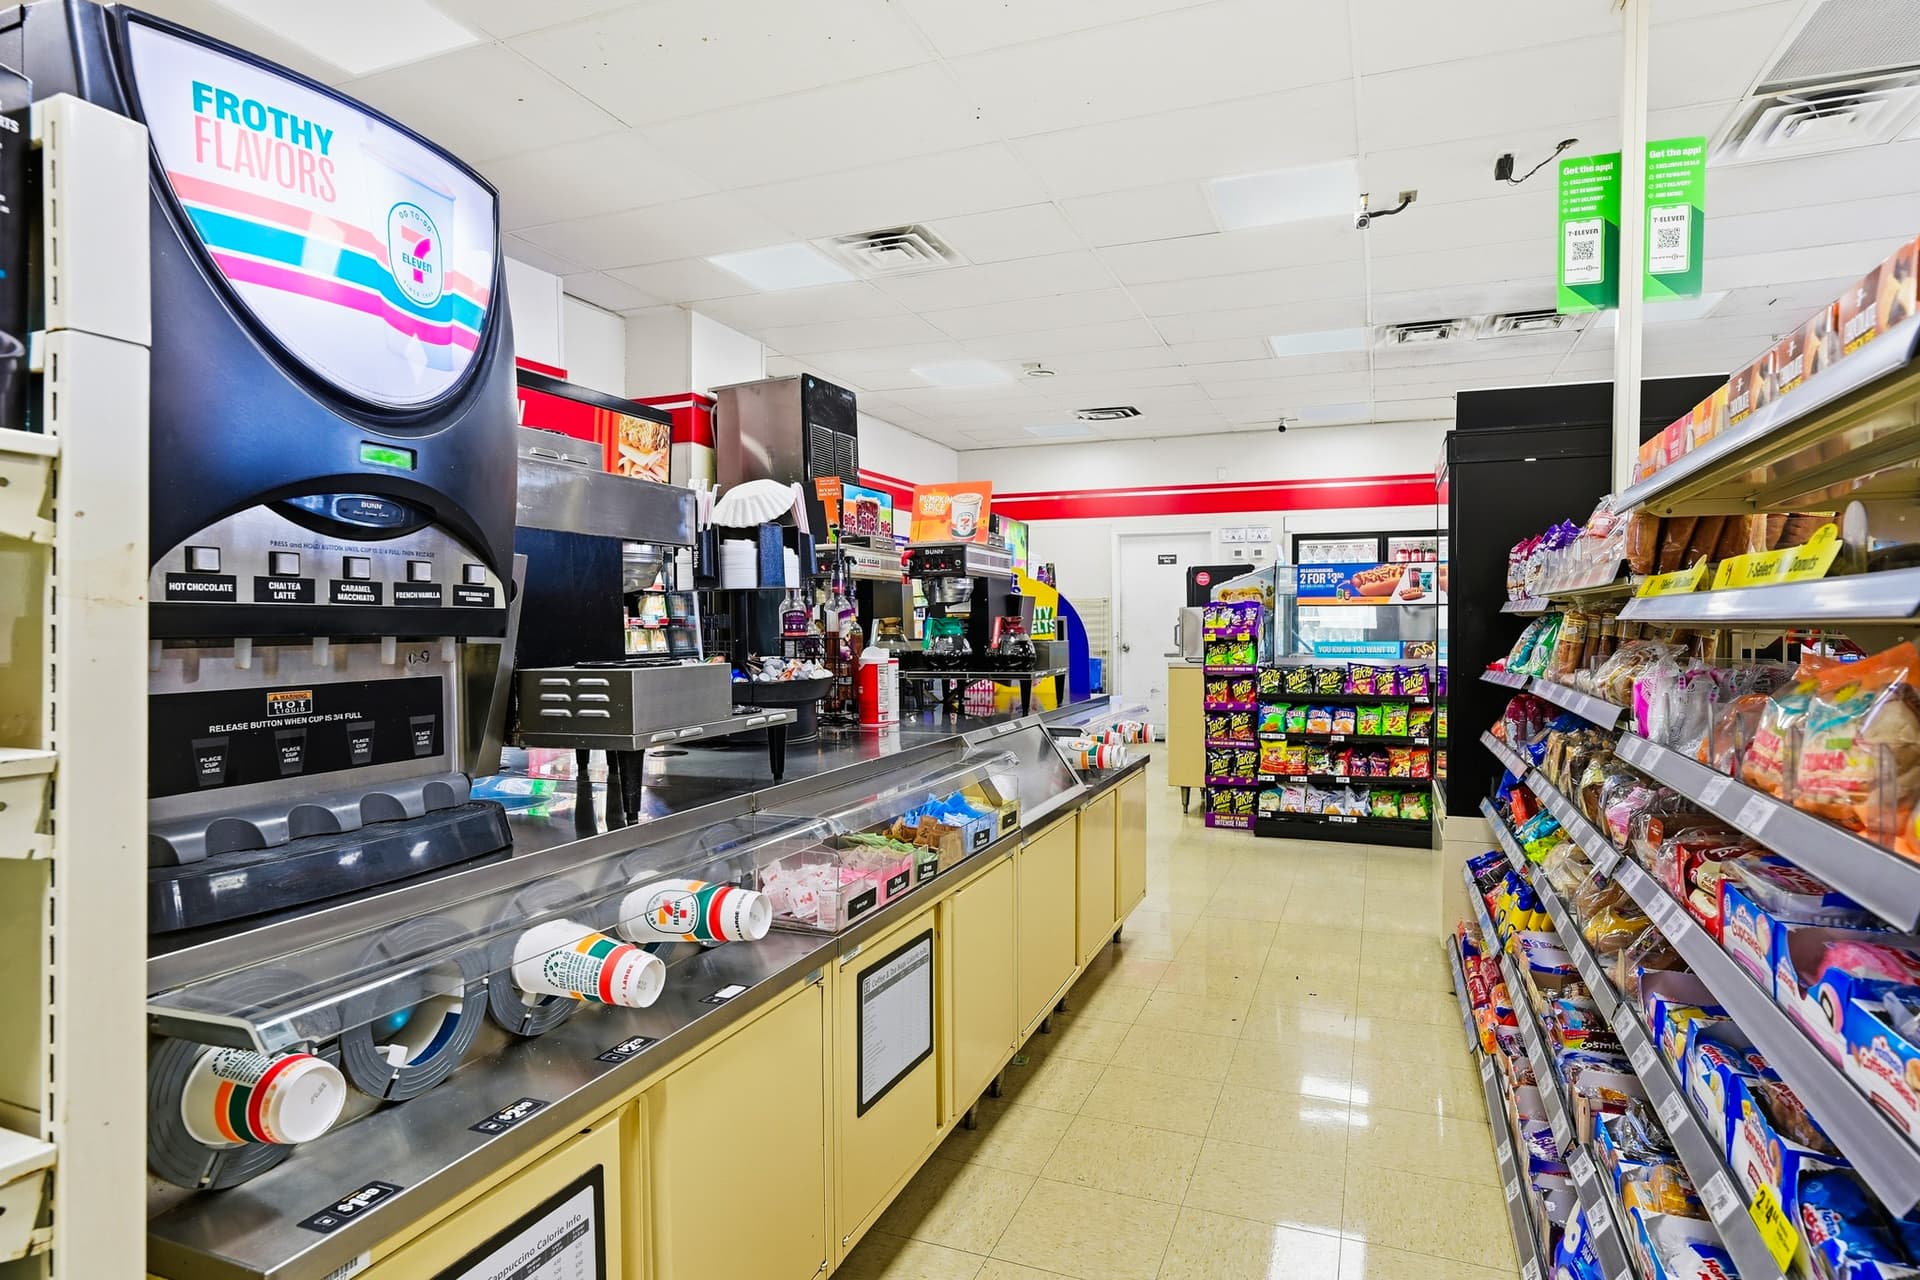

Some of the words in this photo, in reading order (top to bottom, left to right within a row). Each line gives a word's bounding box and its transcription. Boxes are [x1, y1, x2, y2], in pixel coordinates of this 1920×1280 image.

[192, 80, 333, 156] FROTHY
[1650, 149, 1665, 159] Get
[1667, 147, 1681, 157] the
[195, 115, 336, 203] FLAVORS
[1563, 167, 1579, 176] Get
[1580, 165, 1594, 174] the
[361, 501, 383, 510] BUNN
[923, 503, 946, 513] SPICE
[1300, 573, 1306, 584] 2
[1307, 573, 1326, 584] FOR
[169, 582, 185, 591] HOT
[186, 582, 233, 592] CHOCOLATE
[268, 581, 287, 590] CHAI
[287, 582, 301, 590] TEA
[341, 584, 371, 593] CARAMEL
[273, 591, 296, 600] LATTE
[338, 593, 375, 602] MACCHIATO
[395, 591, 417, 599] FRENCH
[1259, 669, 1280, 686] Takis
[1286, 669, 1308, 688] Takis
[1351, 666, 1373, 682] Takis
[1403, 673, 1424, 692] Takis
[280, 692, 307, 700] WARNING
[274, 700, 306, 710] HOT
[209, 722, 249, 733] RELEASE
[250, 720, 283, 729] BUTTON
[284, 717, 307, 726] WHEN
[344, 712, 362, 720] FULL
[200, 755, 222, 763] PLACE
[1235, 751, 1256, 768] Takis
[1234, 791, 1254, 808] Takis
[537, 1225, 564, 1250] Calorie
[566, 1214, 581, 1230] Info
